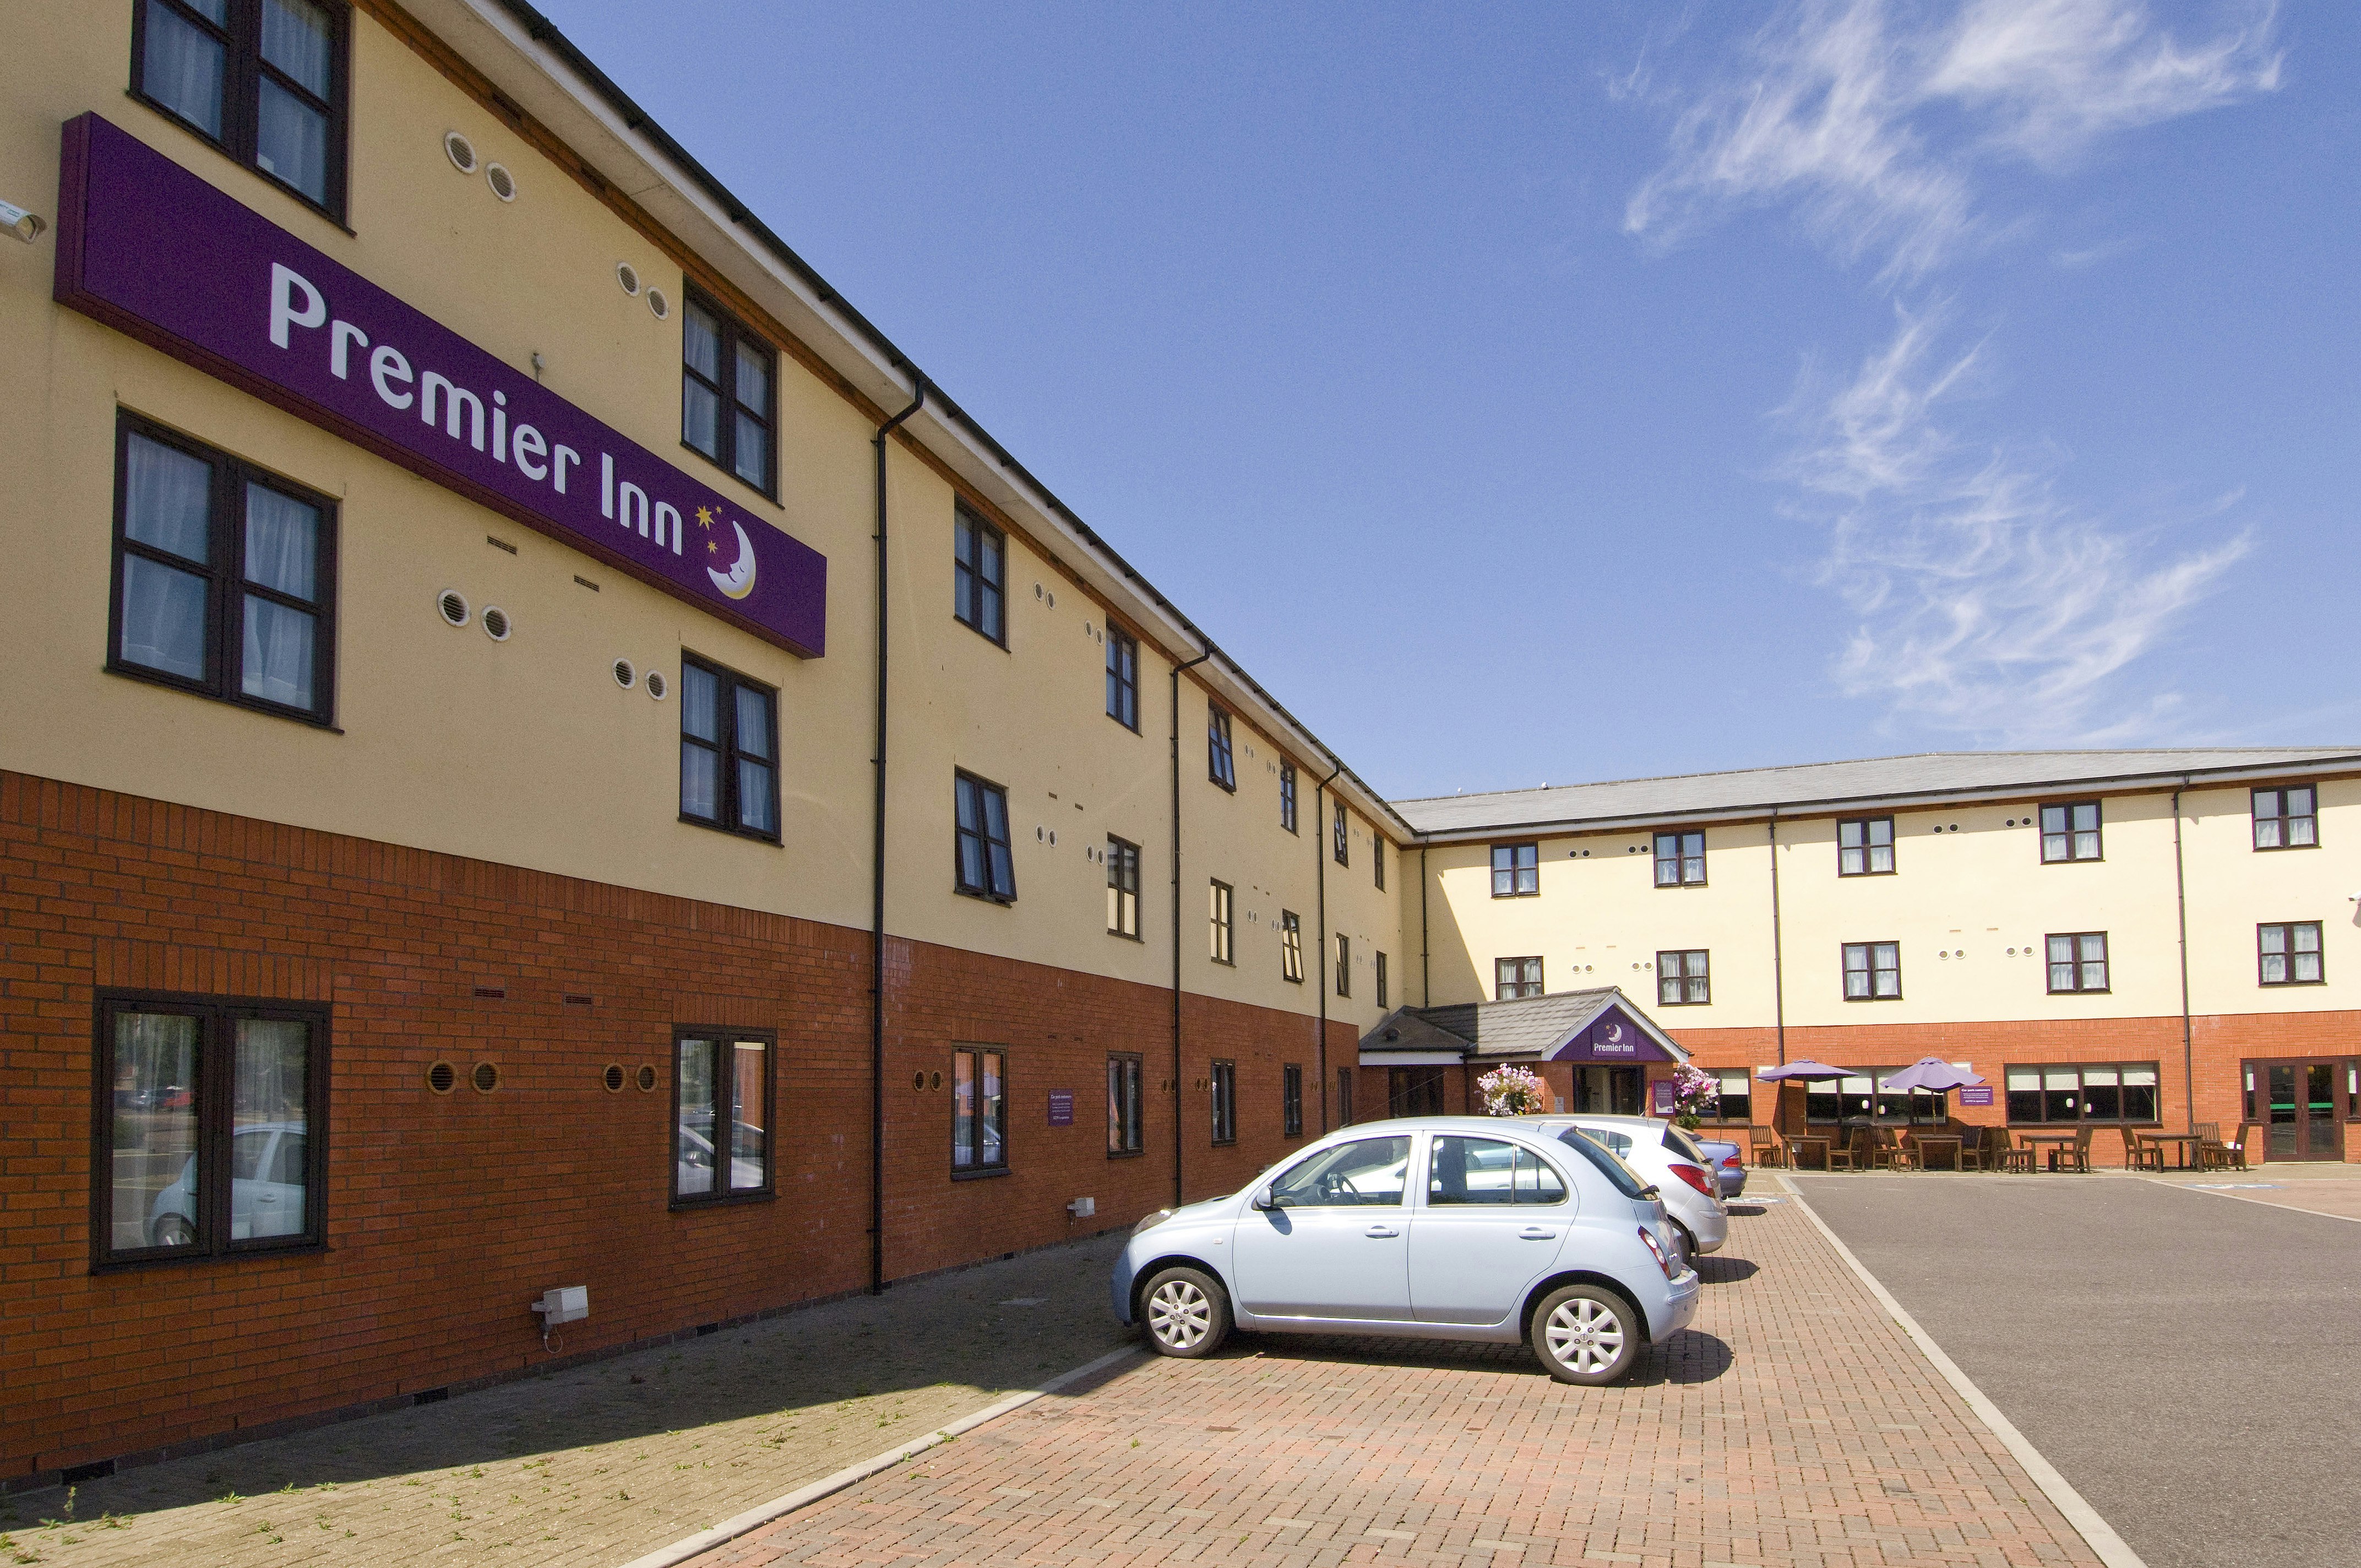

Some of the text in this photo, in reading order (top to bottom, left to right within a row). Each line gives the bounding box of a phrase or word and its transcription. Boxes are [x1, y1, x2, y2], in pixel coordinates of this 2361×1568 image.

[269, 262, 683, 556] Premier Inn
[1594, 1043, 1634, 1052] Premier Inn
